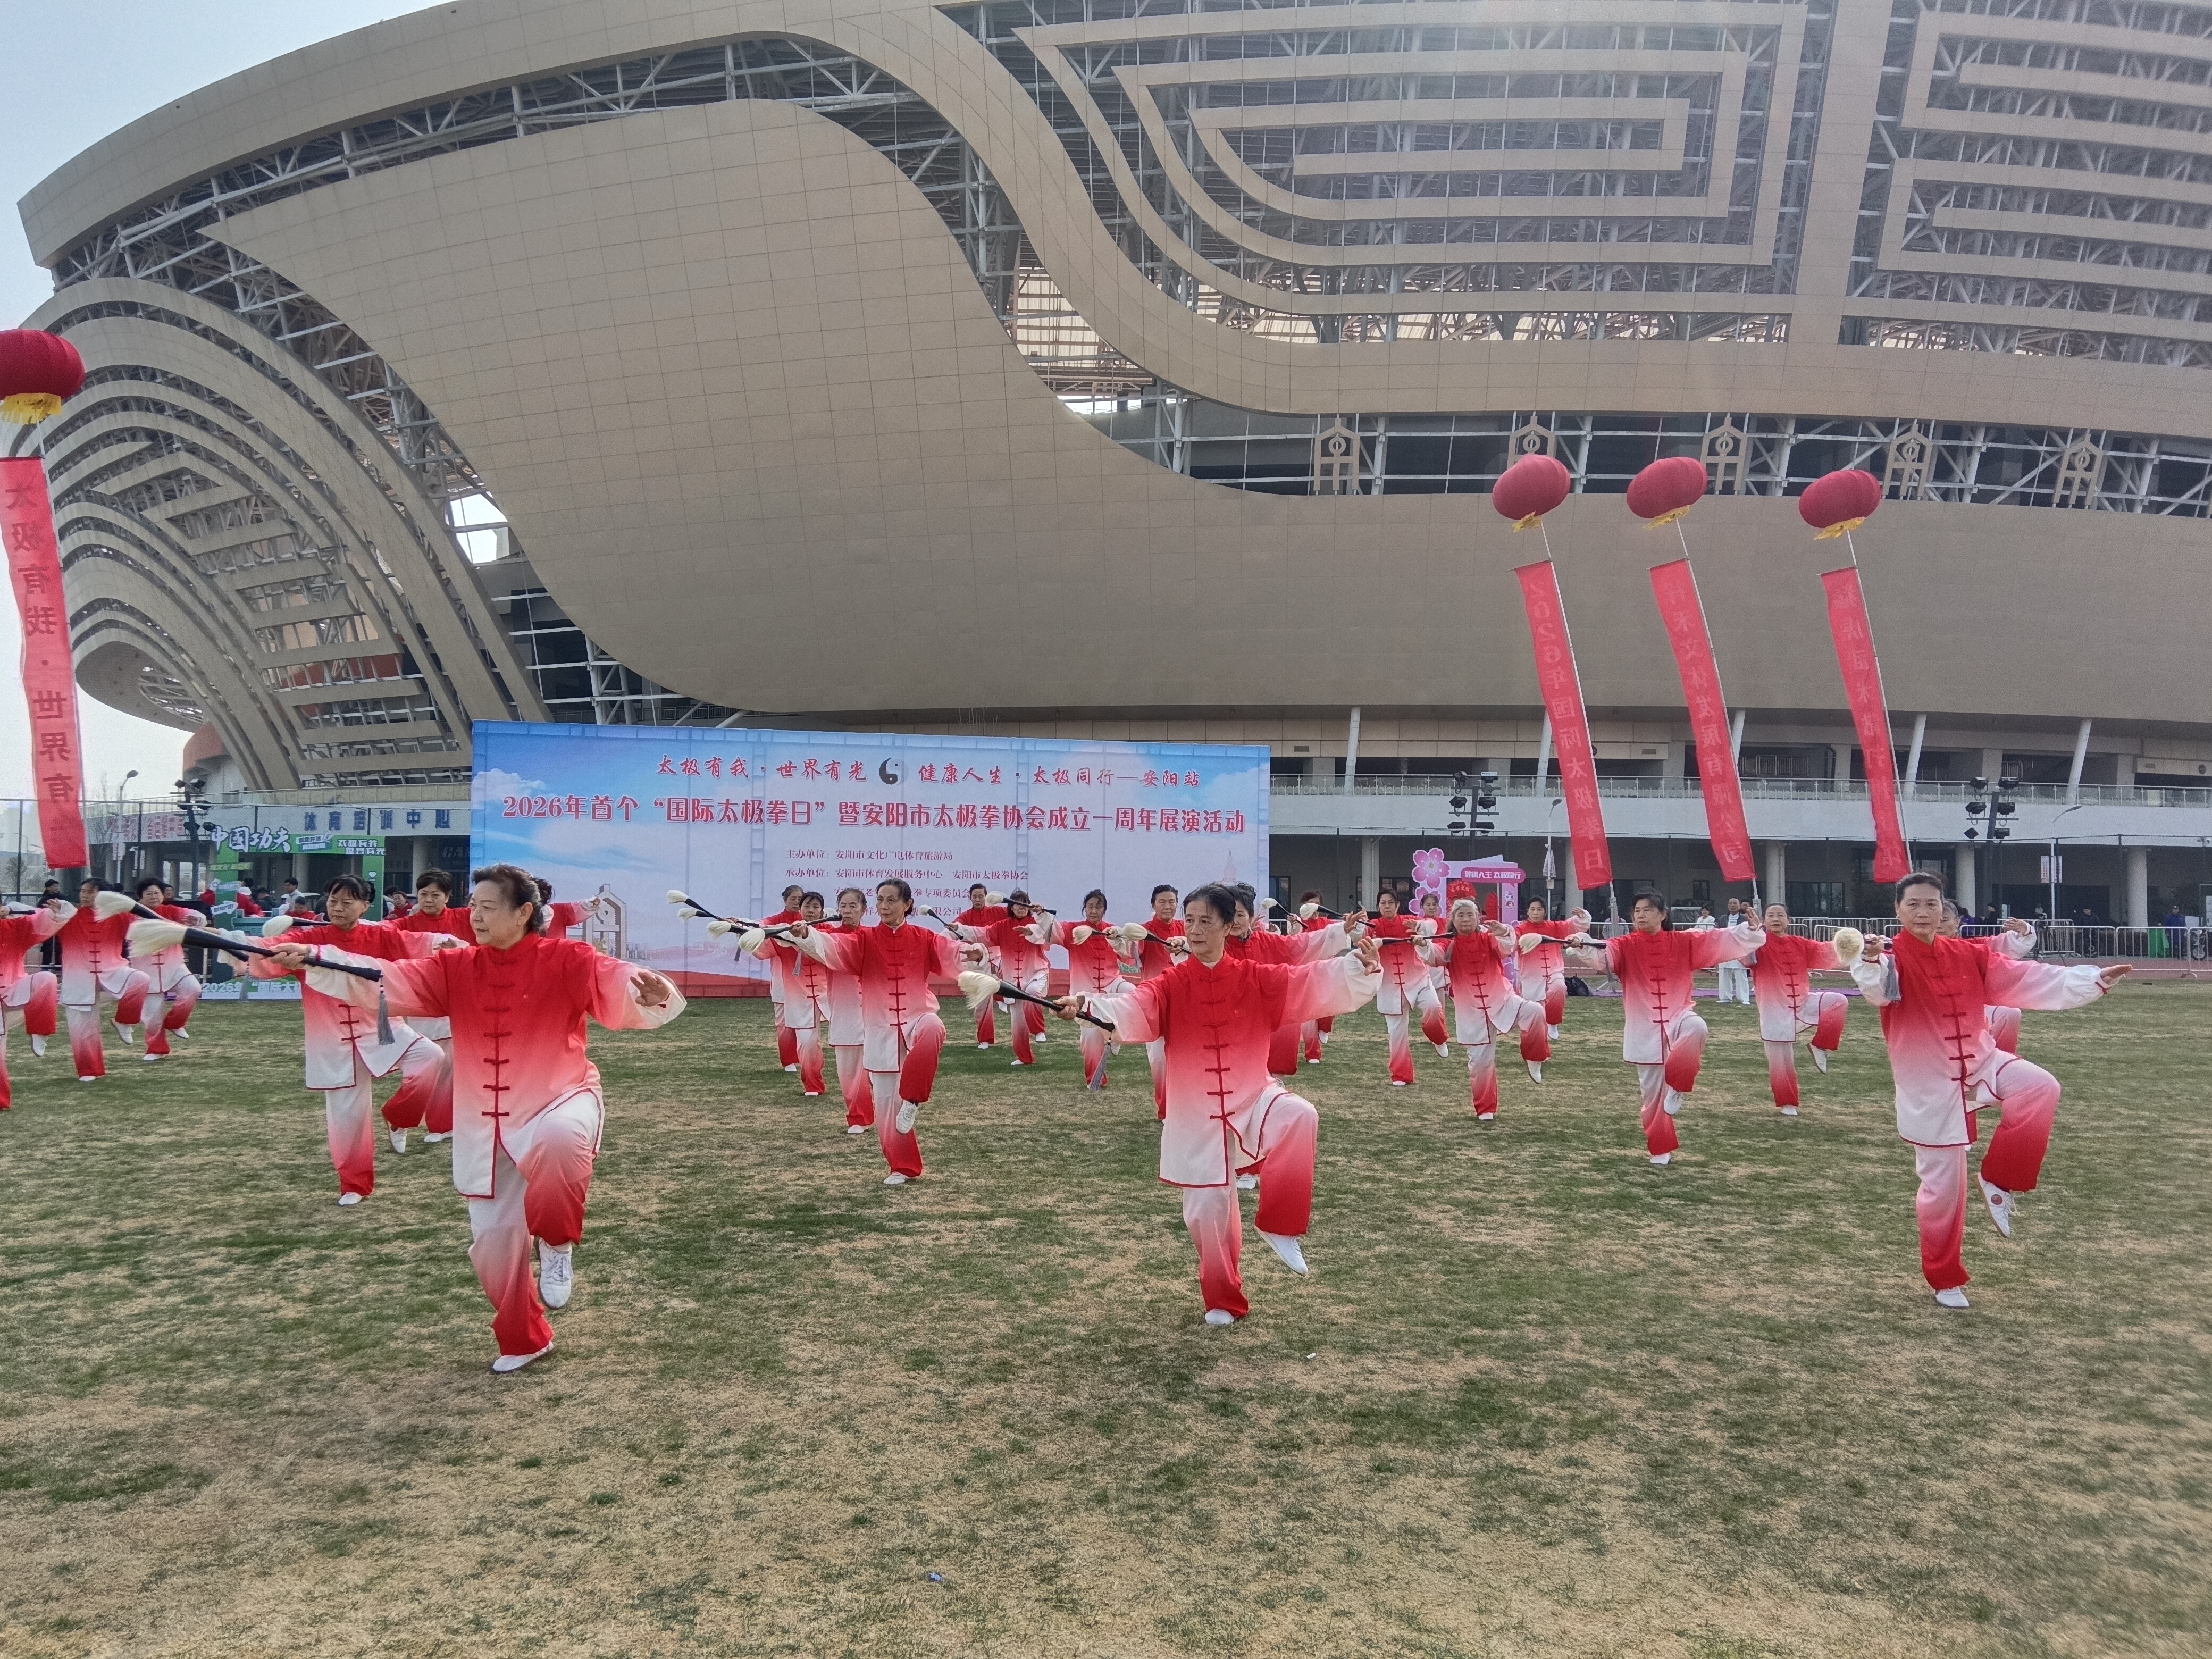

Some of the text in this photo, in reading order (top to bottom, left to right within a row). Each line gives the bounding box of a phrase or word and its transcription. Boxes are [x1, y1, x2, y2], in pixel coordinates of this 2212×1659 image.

[952, 870, 1029, 880] 安阳市太极拳协会
